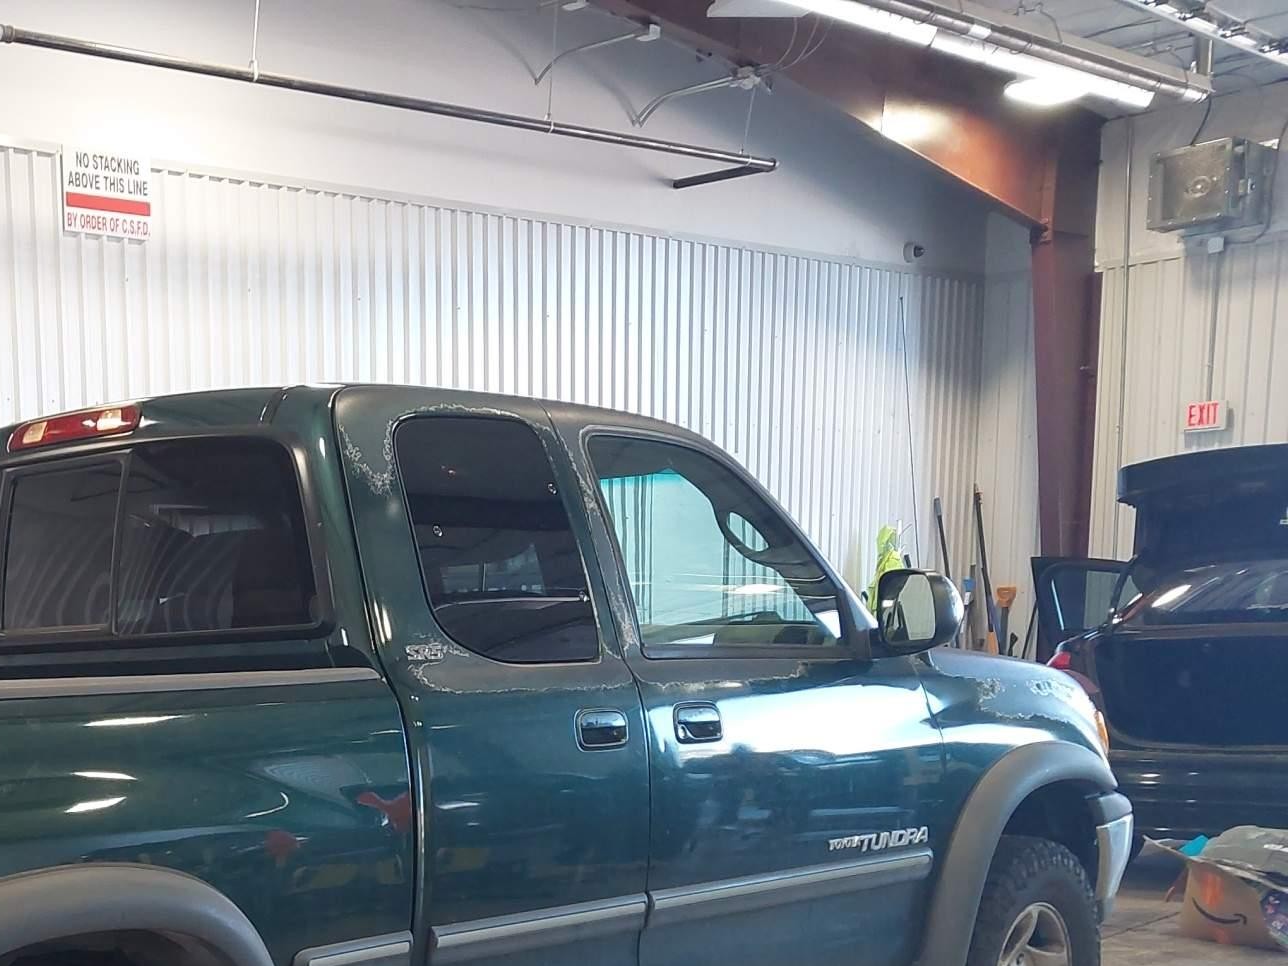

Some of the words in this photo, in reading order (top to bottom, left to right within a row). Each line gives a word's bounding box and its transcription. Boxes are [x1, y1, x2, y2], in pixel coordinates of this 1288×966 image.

[75, 152, 89, 168] NO
[92, 154, 139, 175] STACKING
[68, 171, 100, 190] ABOVE
[103, 175, 124, 193] THIS
[127, 178, 148, 196] LINE
[67, 211, 78, 228] BY
[80, 213, 107, 231] ORDER
[109, 217, 119, 232] OF
[1187, 402, 1219, 426] EXIT
[860, 826, 928, 852] TUNDRA
